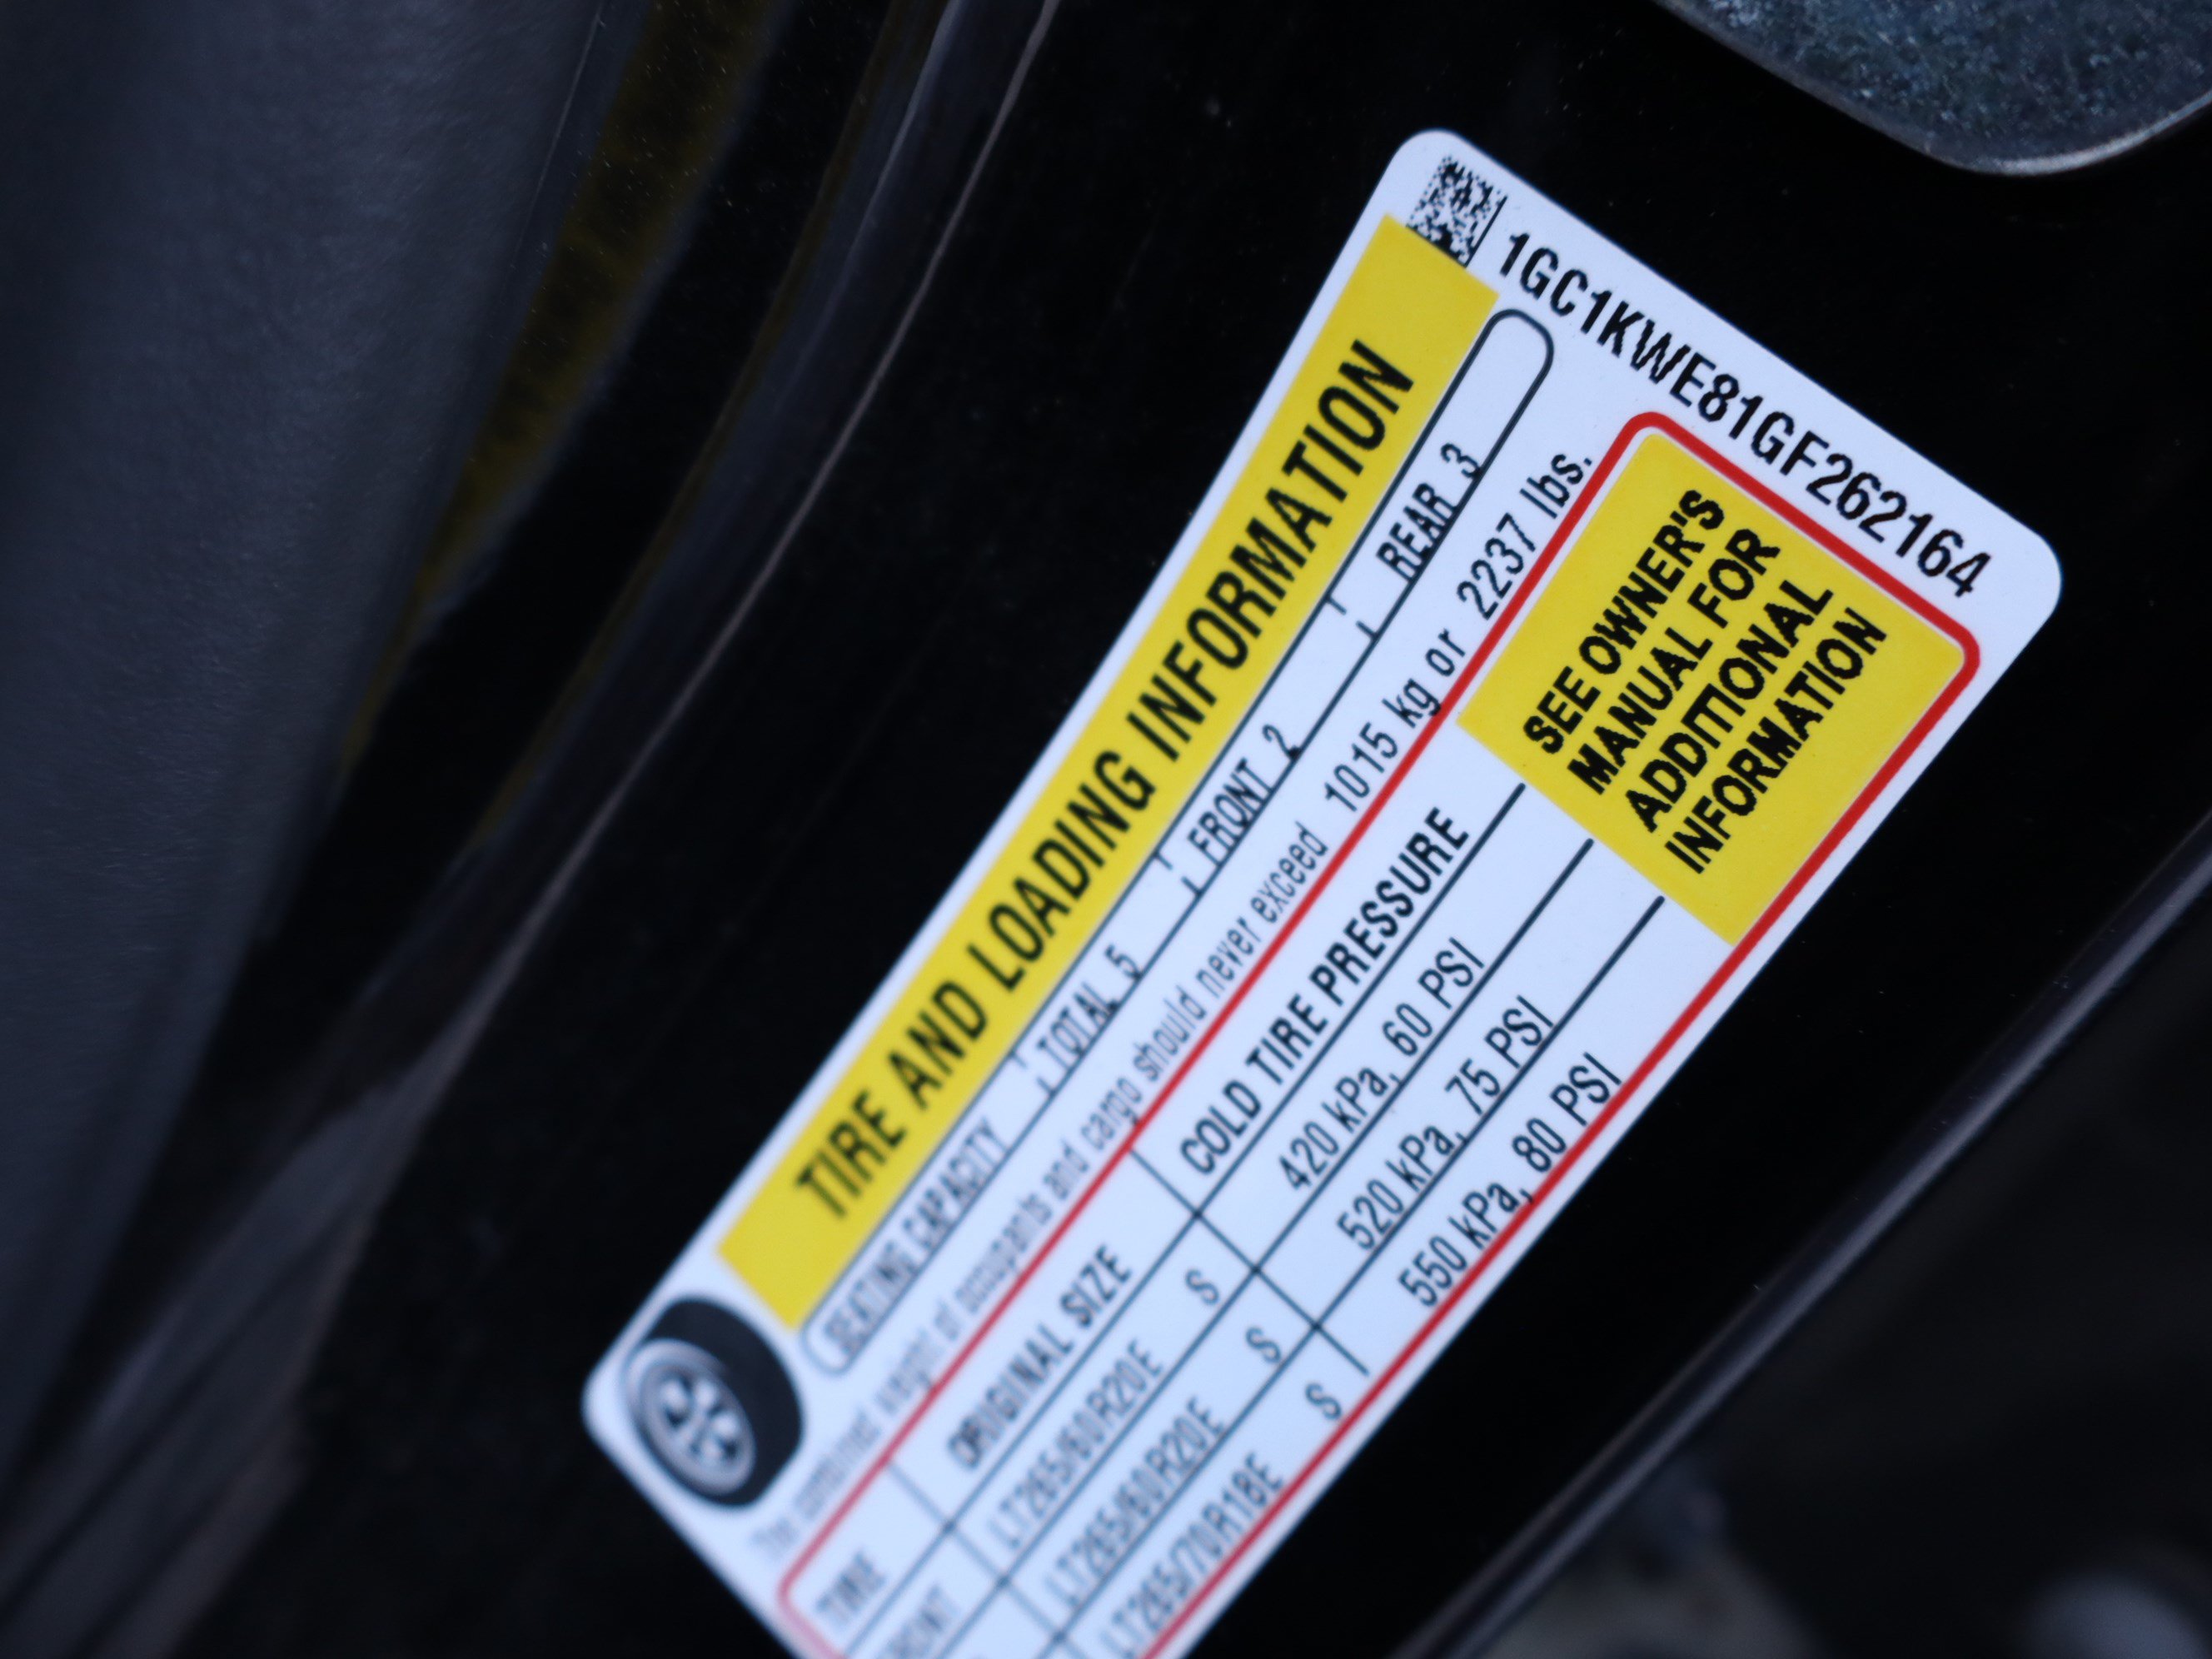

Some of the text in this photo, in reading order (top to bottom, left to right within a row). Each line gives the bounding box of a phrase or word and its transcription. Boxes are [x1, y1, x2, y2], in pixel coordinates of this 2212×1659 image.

[1375, 440, 1485, 583] REAR 3
[1503, 235, 1990, 597] 1GC1KWE81GF262164
[1520, 486, 1729, 757] SEE OWNER'S
[1567, 523, 1781, 795] MANUAL FOR
[1620, 570, 1834, 833] ADDITIONAL
[1665, 605, 1887, 874] INFORMATION
[793, 337, 1415, 1220] TIRE AND LOADING INFORMATION
[1040, 1139, 1092, 1201] and
[1077, 1077, 1144, 1152] cargo
[1130, 983, 1208, 1083] should
[1197, 917, 1264, 998] never
[1249, 820, 1329, 924] exceed
[1319, 720, 1402, 816] 1015
[1380, 677, 1442, 729] kg
[1422, 627, 1467, 680] or
[1452, 511, 1542, 621] 2237
[1518, 448, 1593, 519] lbs.
[1185, 721, 1303, 867] FRONT 2
[1175, 805, 1471, 1178] COLD TIRE PRESSURE
[1273, 936, 1486, 1195] 420 kPa, 60 PSI
[820, 942, 1145, 1361] SEATING CAPACITY TOTAL 5
[1335, 994, 1555, 1253] 520 kPa, 75 PSI
[1396, 1050, 1623, 1309] 550 kPa, 80 PSI
[942, 1243, 1133, 1473] ORIGINAL SIZE
[1180, 1265, 1225, 1308] S
[1243, 1323, 1288, 1366] S
[1301, 1378, 1346, 1422] S
